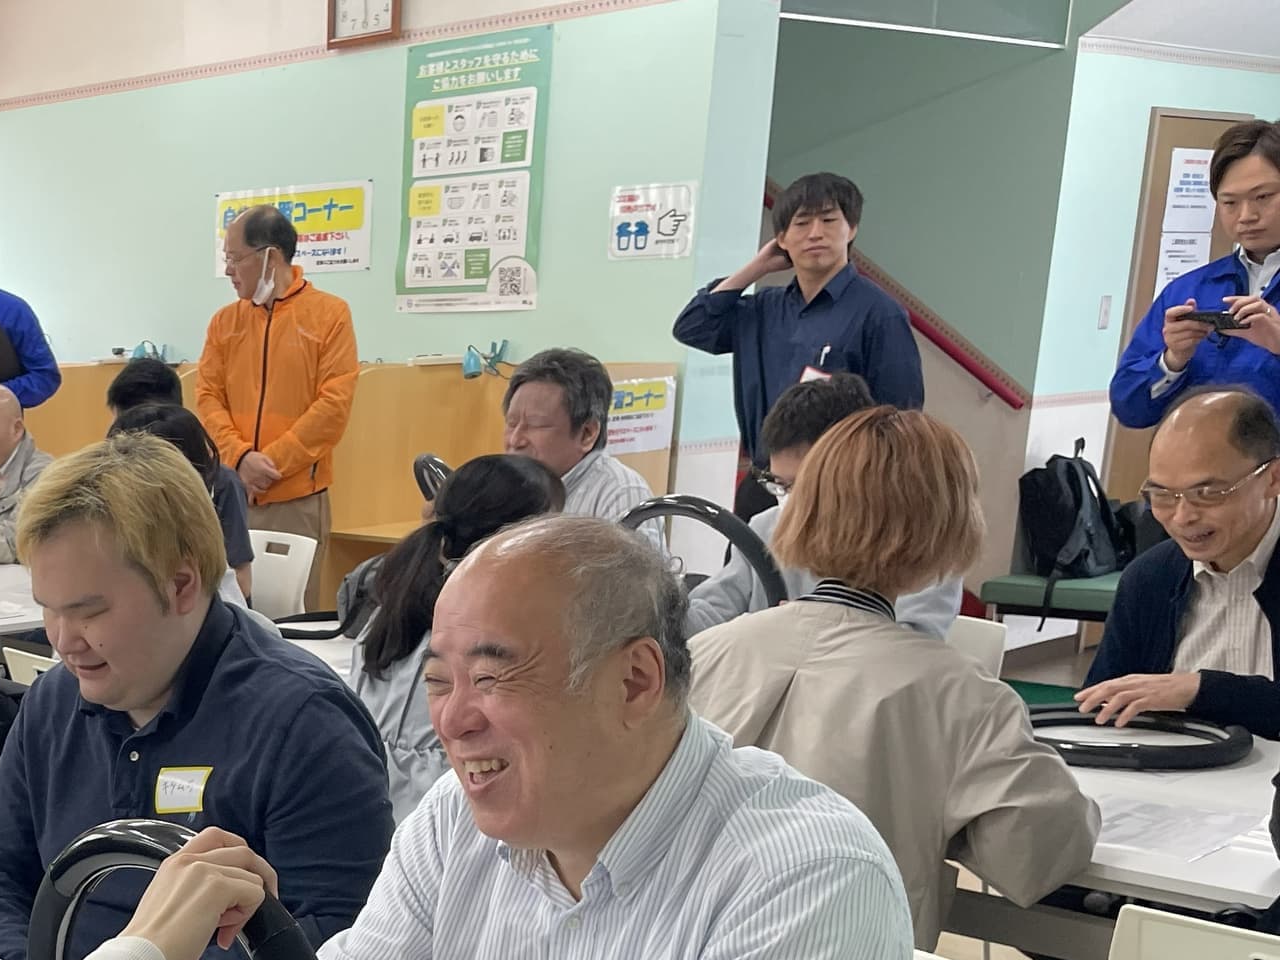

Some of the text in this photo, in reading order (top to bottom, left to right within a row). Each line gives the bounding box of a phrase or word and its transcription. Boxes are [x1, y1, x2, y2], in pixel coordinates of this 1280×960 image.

[418, 48, 539, 76] お客様とスタッフを守るために
[433, 67, 522, 90] ご協力をお願いします
